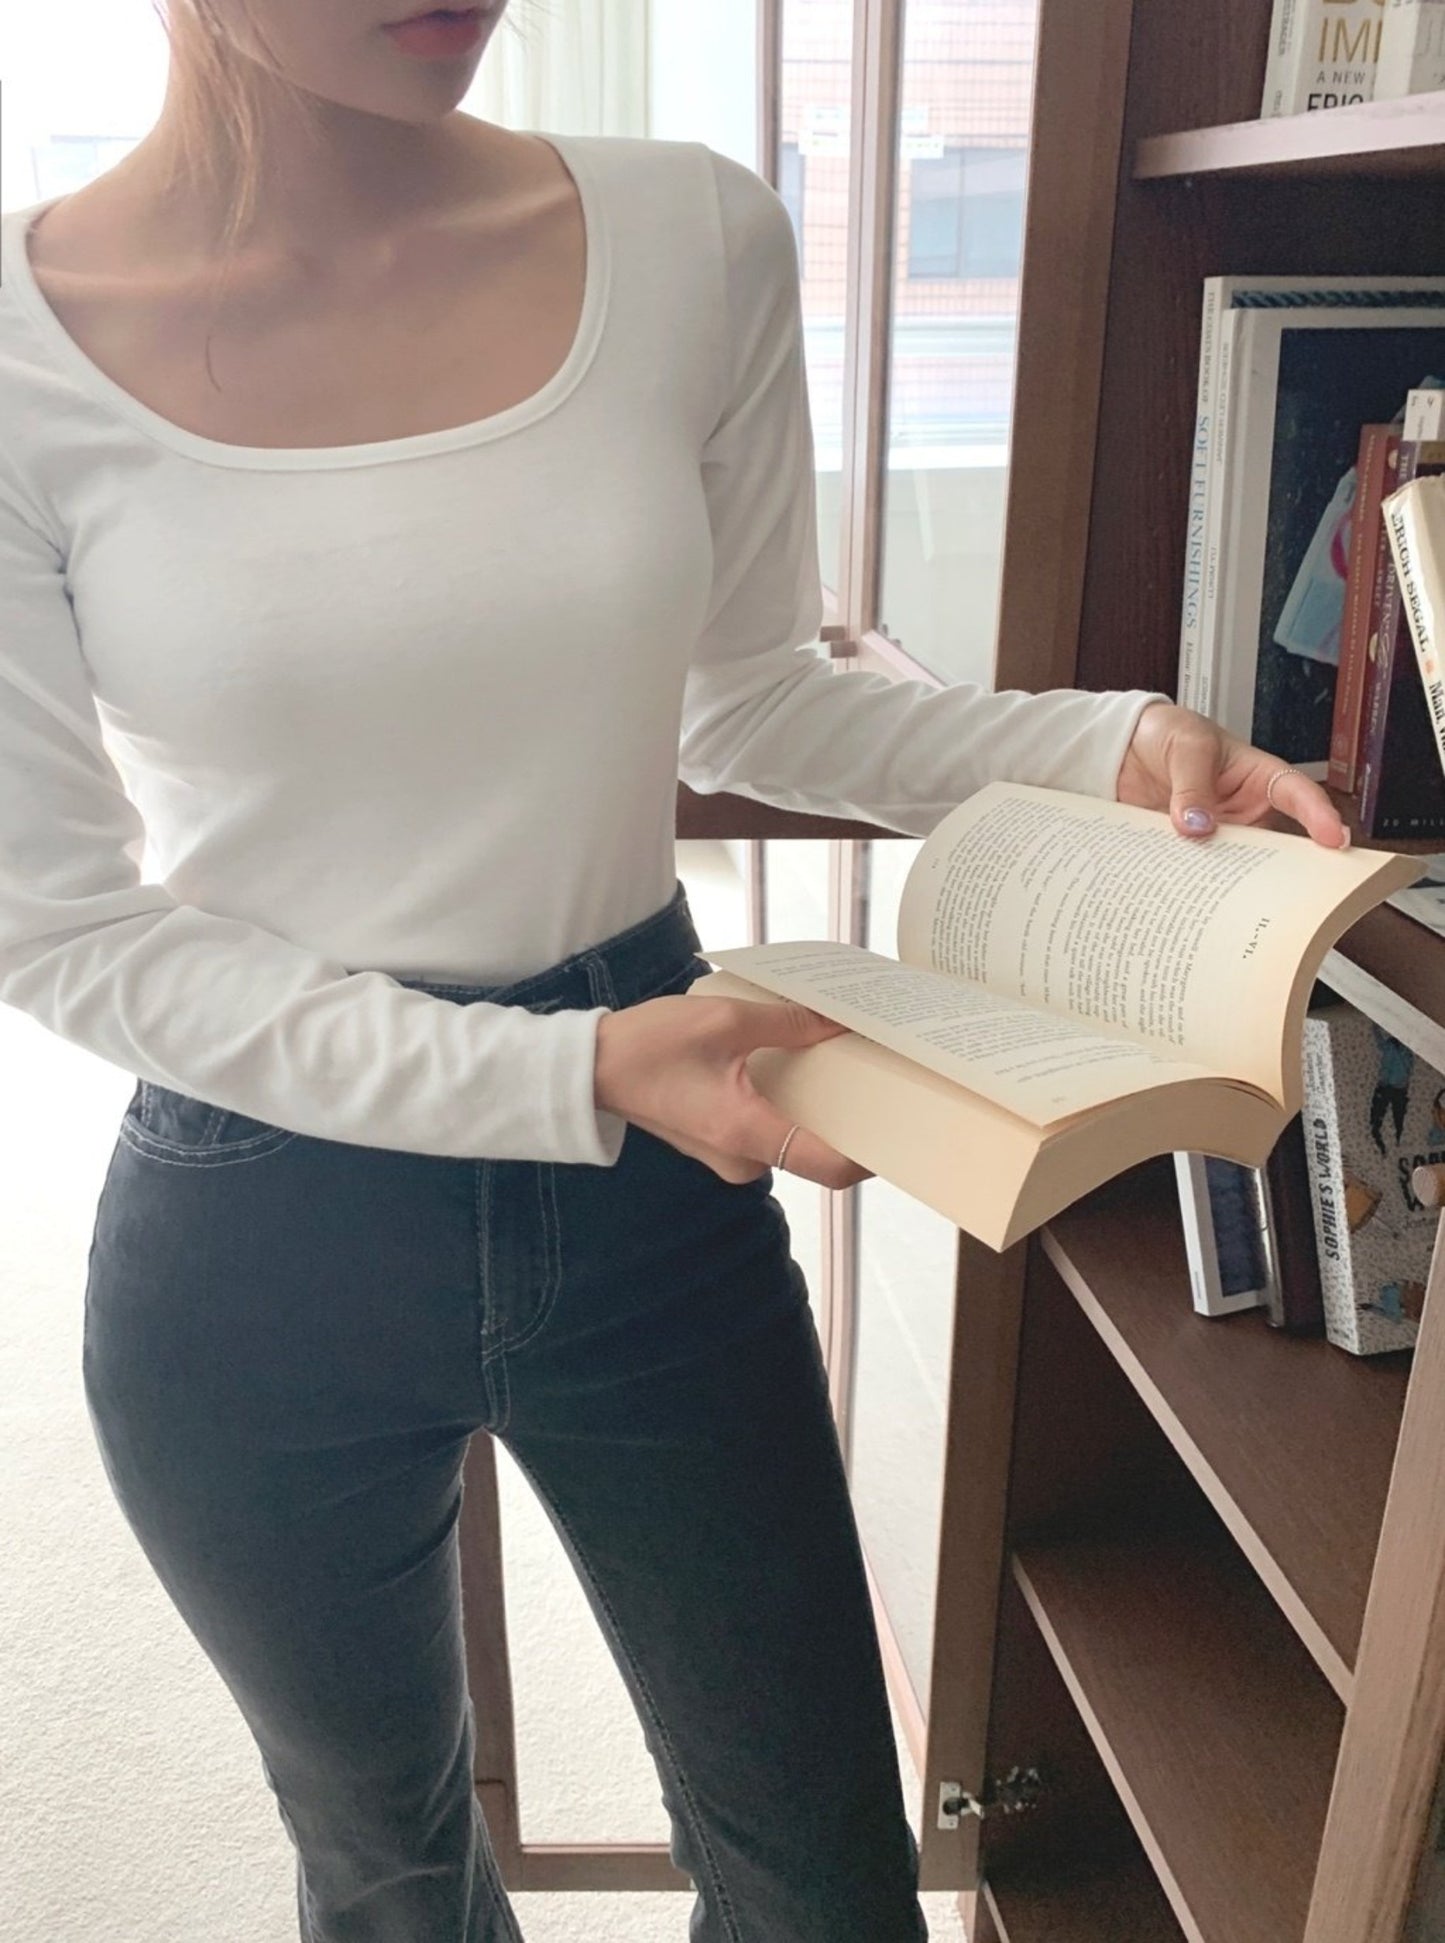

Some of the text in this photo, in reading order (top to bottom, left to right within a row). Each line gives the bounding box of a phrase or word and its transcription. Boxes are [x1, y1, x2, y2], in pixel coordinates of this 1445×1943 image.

[1332, 70, 1368, 85] NEW
[1194, 415, 1209, 470] SOFT
[1186, 479, 1206, 629] FURNISHINGS
[1390, 512, 1412, 578] ERICH
[1406, 580, 1430, 653] SEGAL
[1313, 1117, 1332, 1179] WORLD
